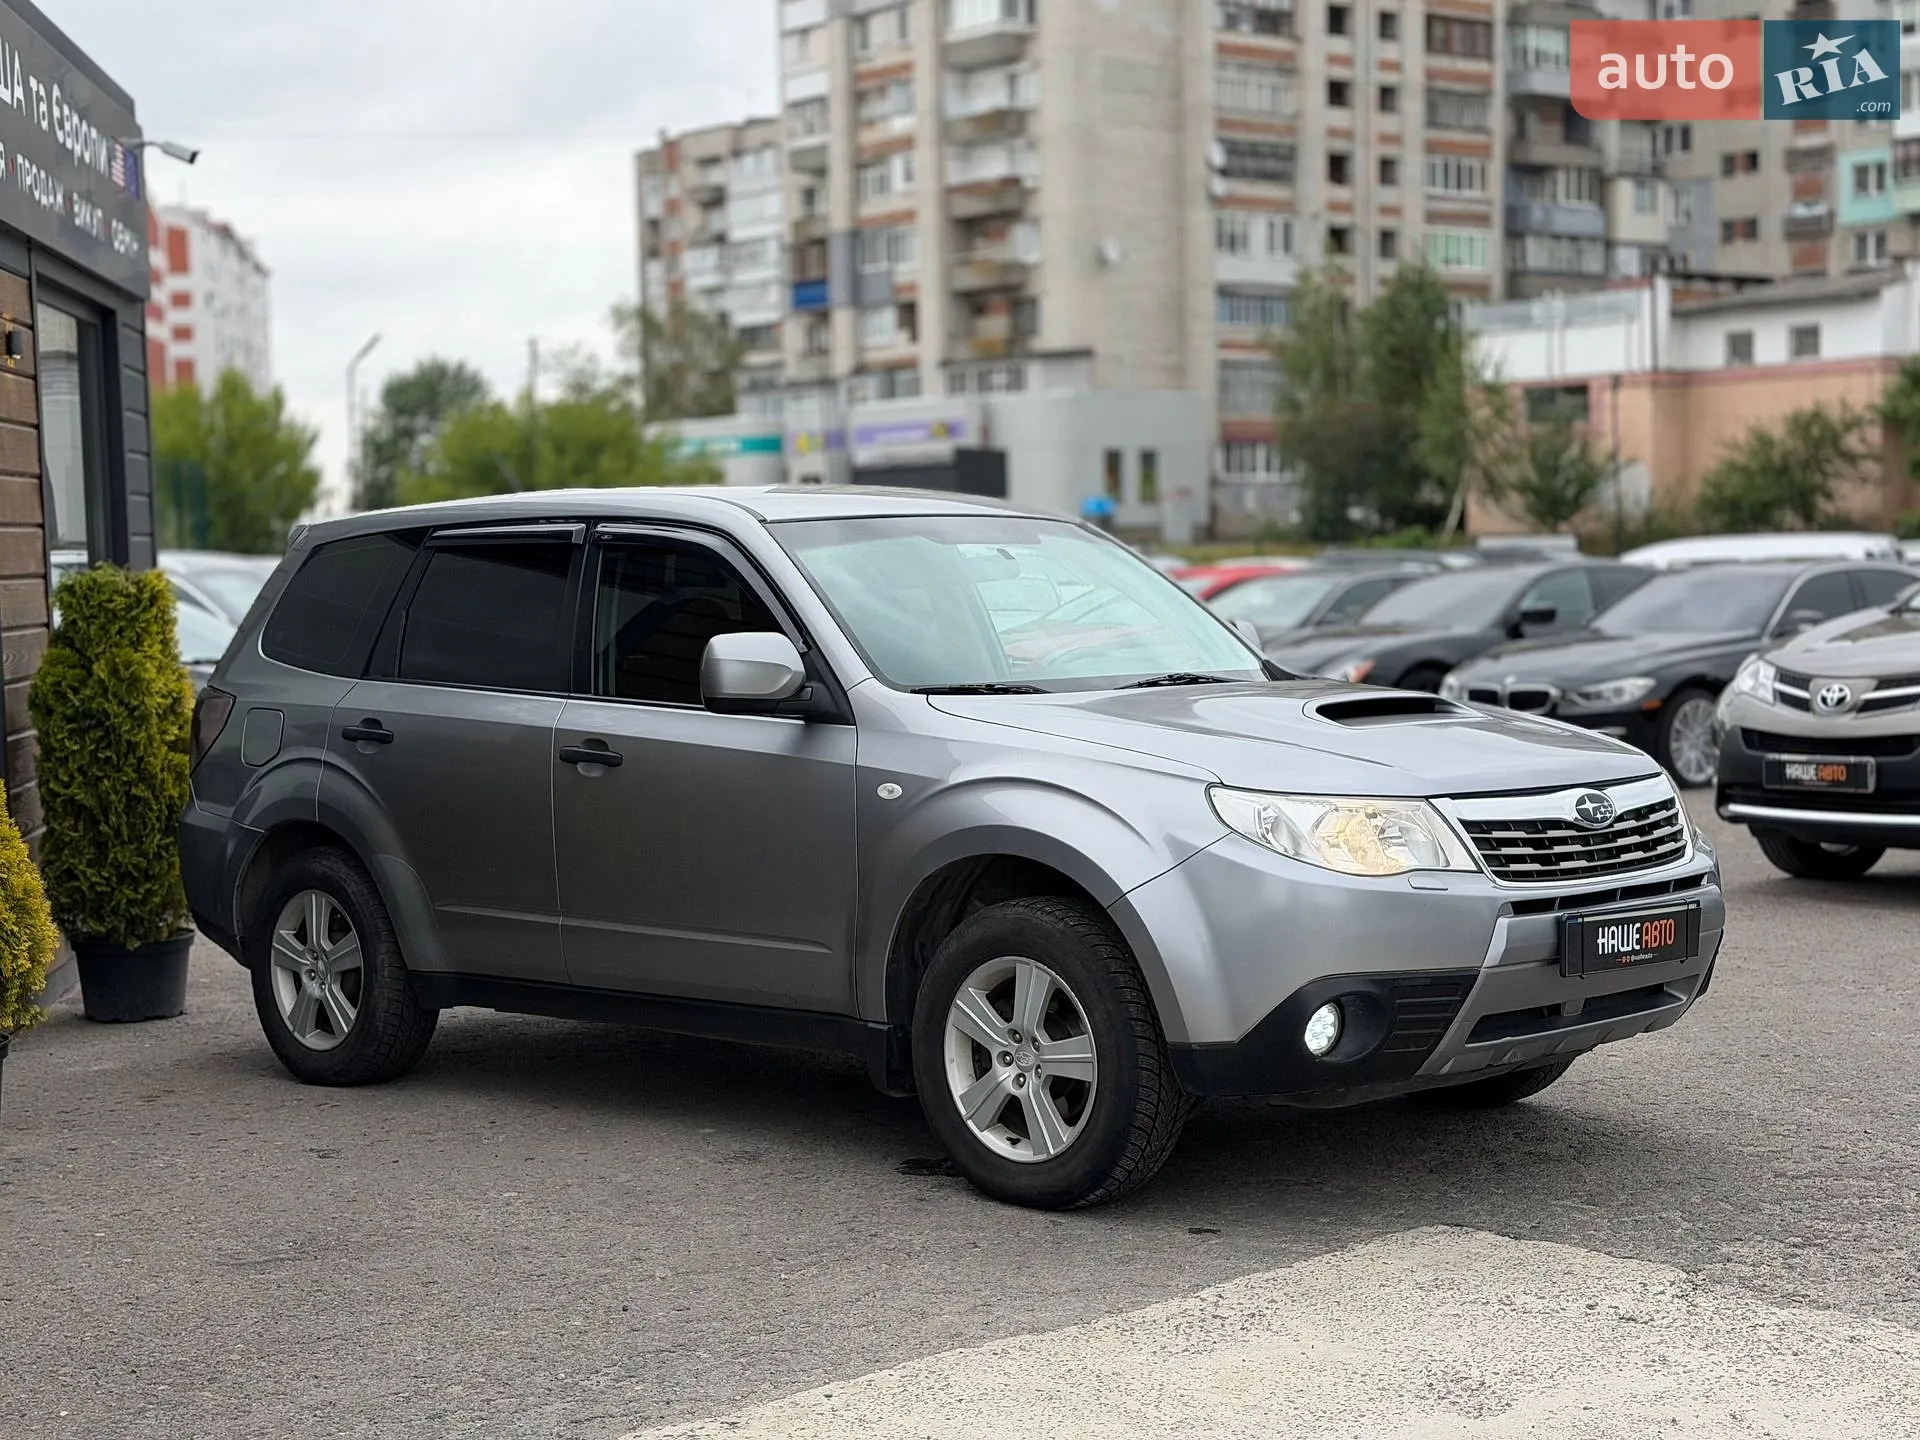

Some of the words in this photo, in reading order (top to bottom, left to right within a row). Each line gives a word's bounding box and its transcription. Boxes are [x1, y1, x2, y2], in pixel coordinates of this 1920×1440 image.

[29, 75, 49, 132] та
[52, 83, 109, 177] Європи
[17, 153, 65, 217] ПРОДАЖ
